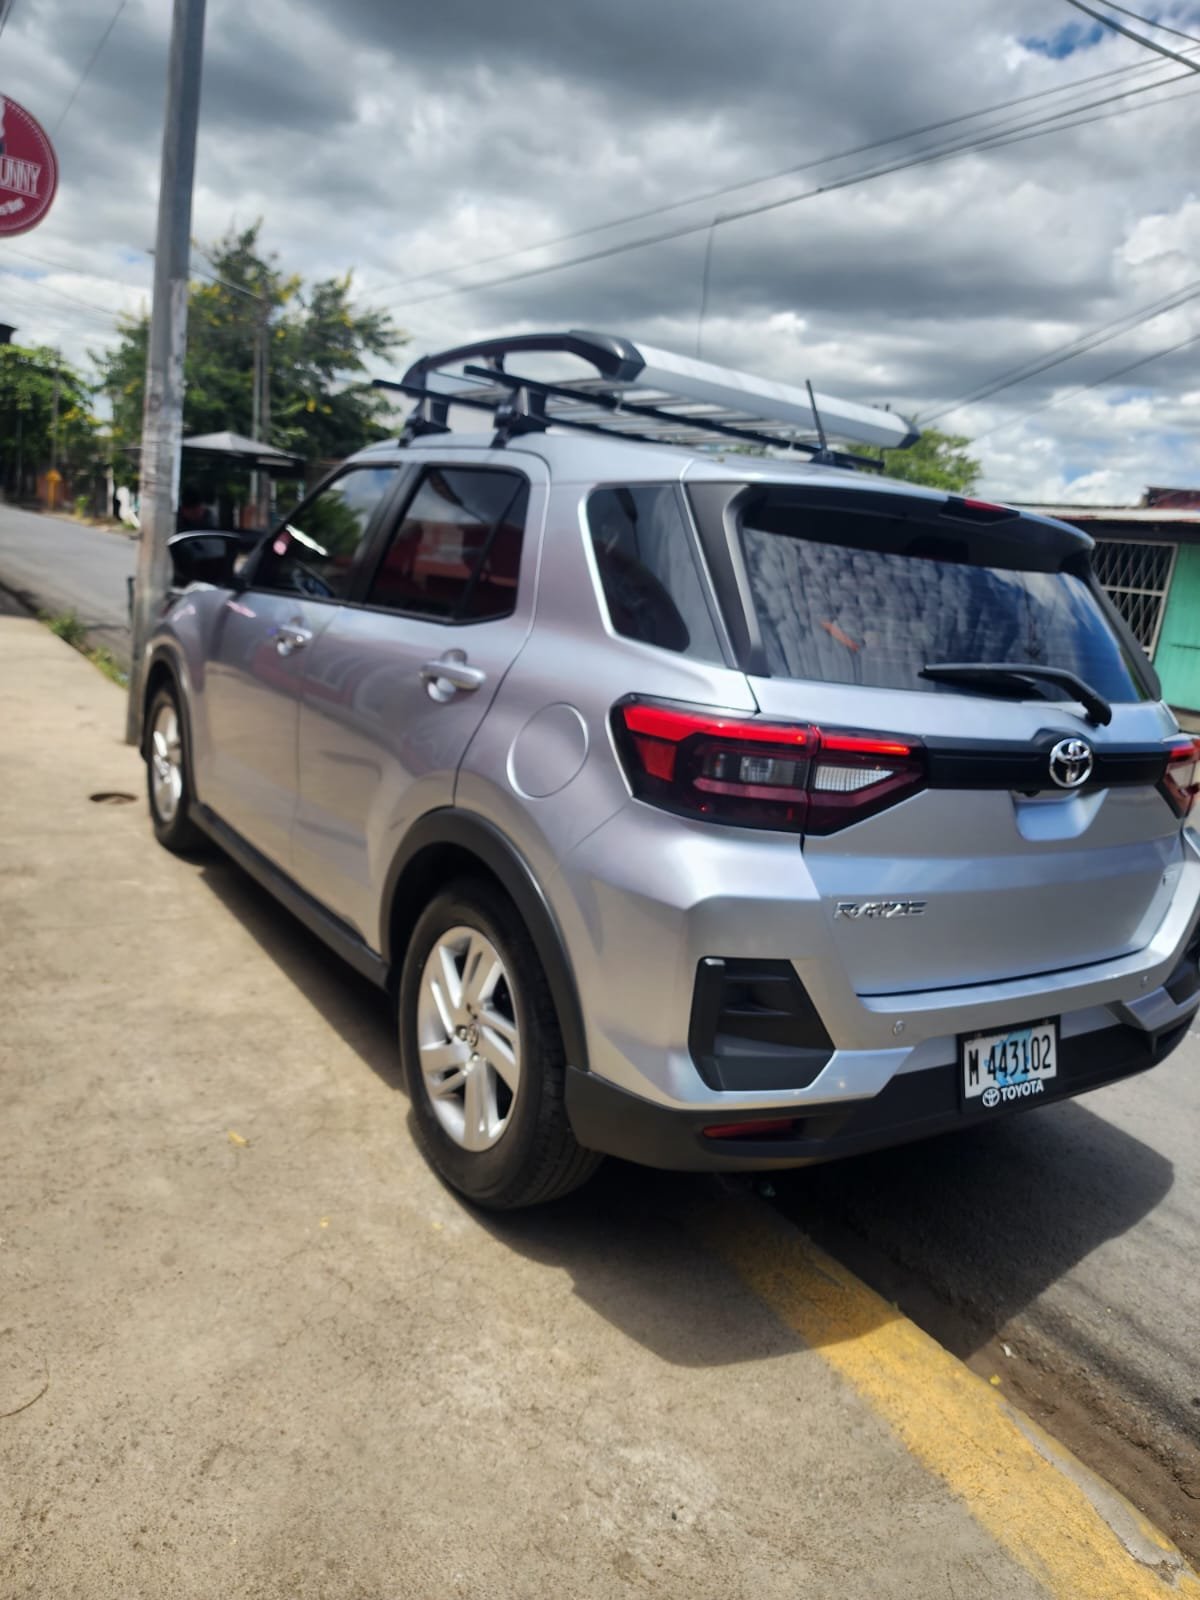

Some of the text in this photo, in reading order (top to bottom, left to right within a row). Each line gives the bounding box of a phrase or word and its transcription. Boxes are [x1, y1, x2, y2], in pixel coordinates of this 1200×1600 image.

[833, 900, 928, 918] RAIZE
[968, 1034, 1052, 1087] M 443102
[1000, 1079, 1044, 1102] TOYOTA
